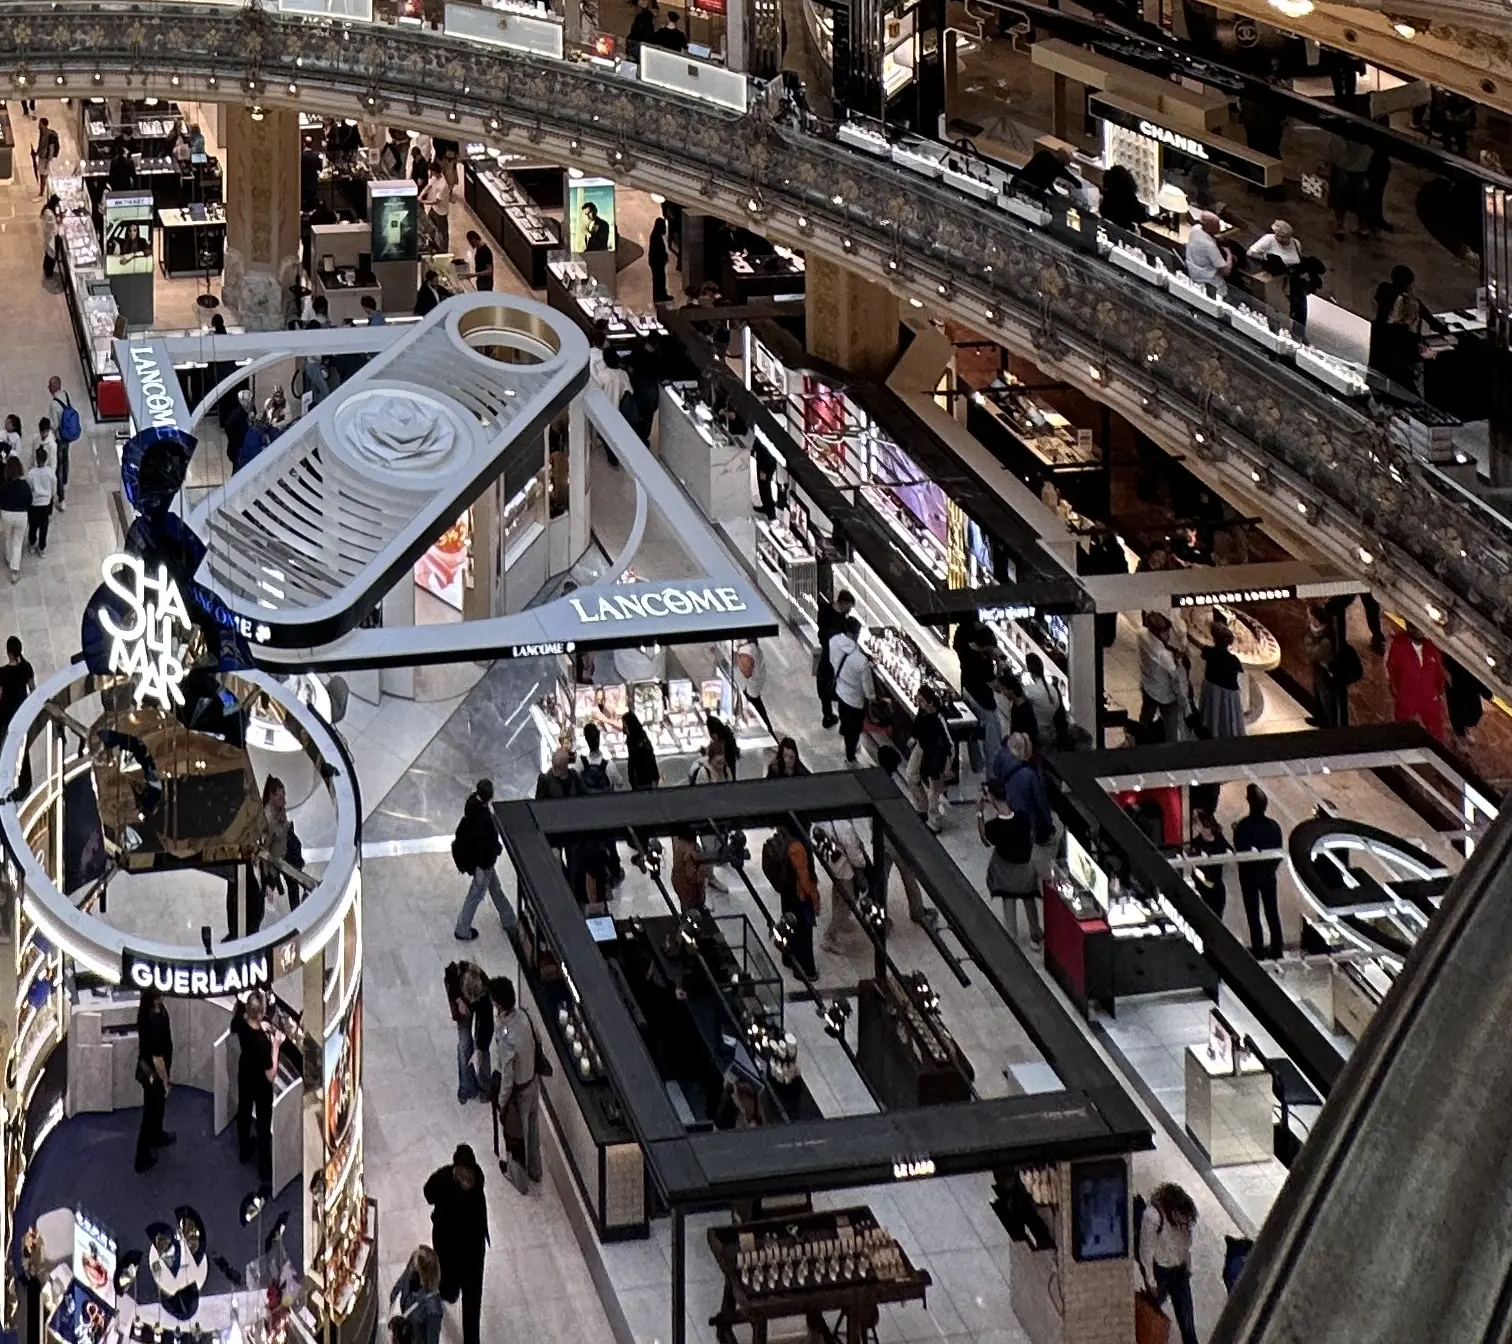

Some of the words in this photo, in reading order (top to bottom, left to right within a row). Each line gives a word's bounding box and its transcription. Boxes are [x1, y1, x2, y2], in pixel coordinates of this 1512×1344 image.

[1139, 120, 1210, 160] CHANEL
[129, 345, 178, 430] LANCÔM
[569, 587, 747, 623] LANCÔME
[131, 955, 269, 995] GUERLAIN
